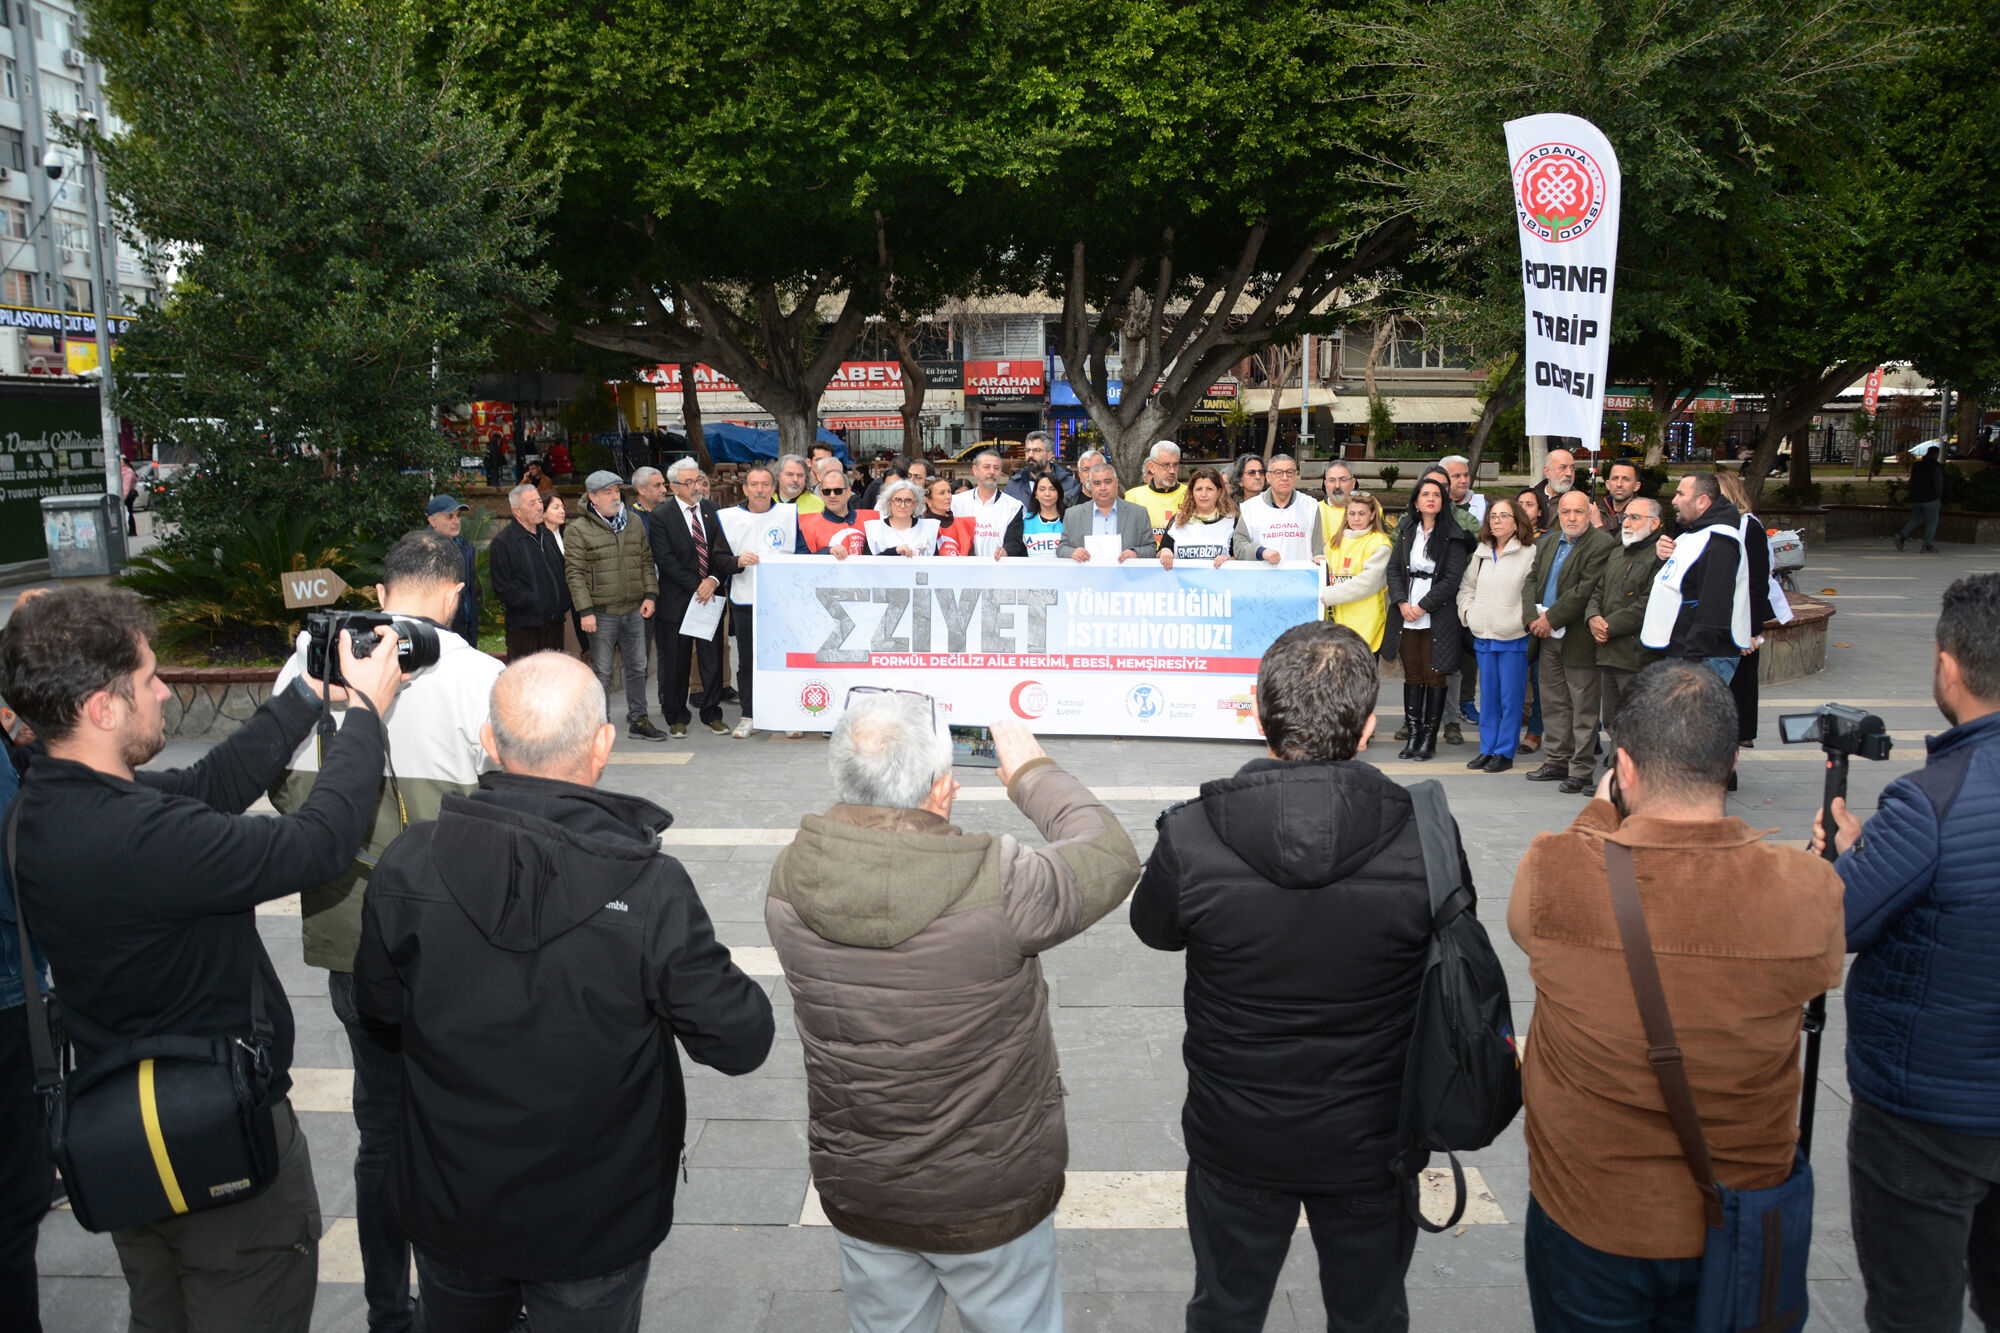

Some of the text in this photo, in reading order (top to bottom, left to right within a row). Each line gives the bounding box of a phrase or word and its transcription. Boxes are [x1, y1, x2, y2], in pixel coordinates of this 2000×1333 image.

[1529, 147, 1586, 164] ADANA
[1560, 201, 1601, 239] ODASI
[1525, 259, 1607, 293] ADANA
[1533, 310, 1598, 345] TABİP
[968, 377, 1040, 386] KARAHAN
[978, 385, 1030, 395] KİTABEVİ
[1535, 361, 1594, 399] ODASI
[834, 420, 874, 429] TATLICI
[292, 579, 329, 600] WC
[1066, 588, 1232, 617] YÖNETMELİĞİNİ
[1067, 618, 1232, 650] İSTEMİYORUZ!
[872, 654, 1207, 671] FORMÜL DEĞİLİZ! AİLE HEKİMİ, EBESİ, HEMŞİRESİYİZ
